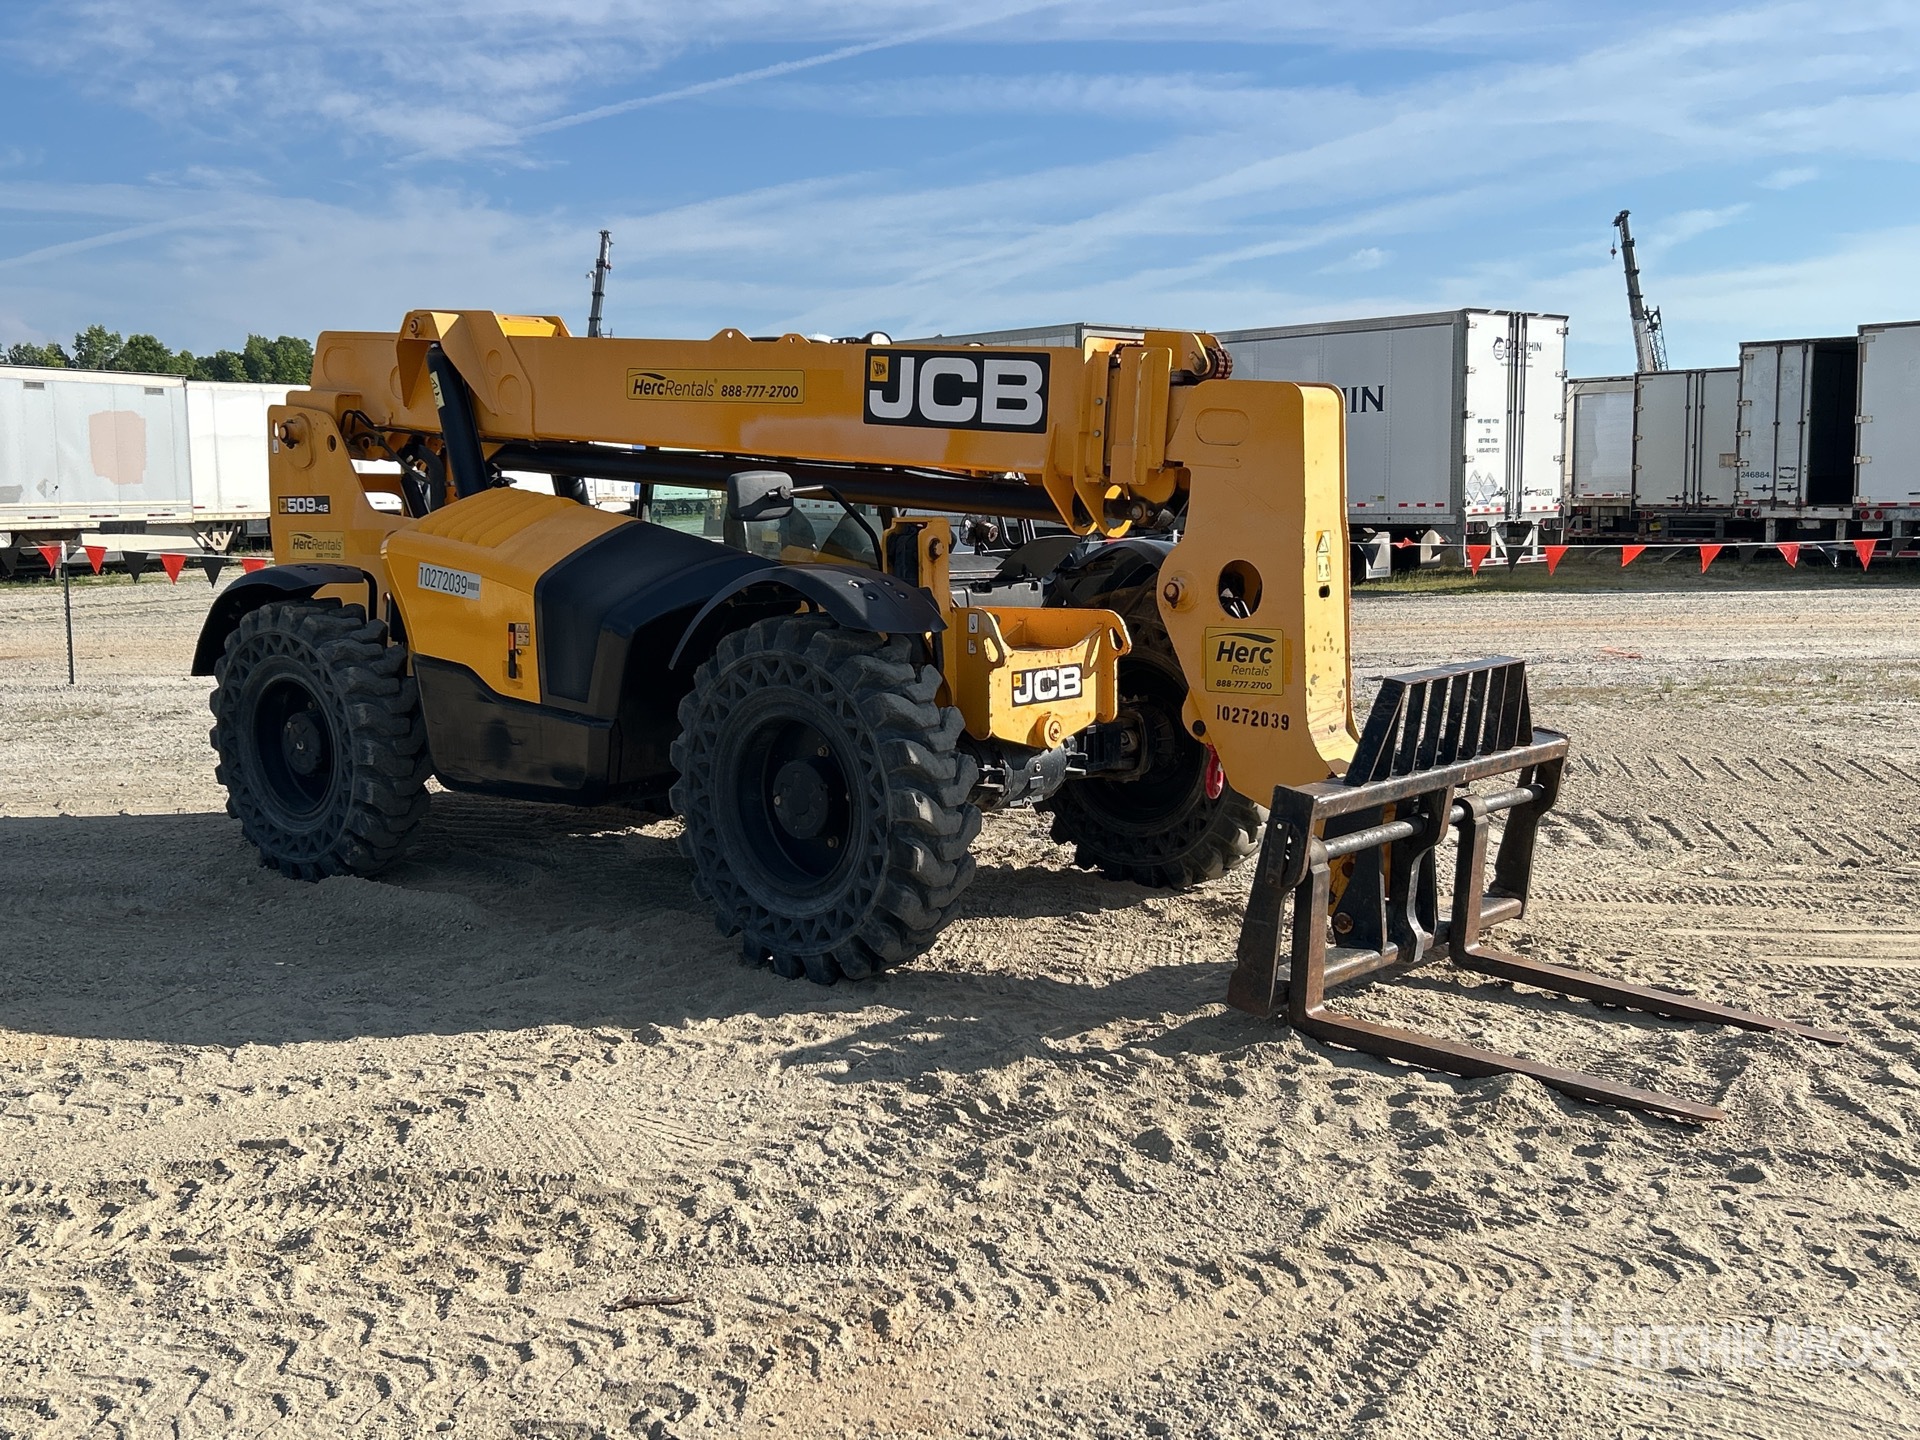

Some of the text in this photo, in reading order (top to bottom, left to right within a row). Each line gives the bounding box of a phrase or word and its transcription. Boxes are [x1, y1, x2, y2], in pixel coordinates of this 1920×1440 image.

[874, 361, 887, 376] JCB
[720, 385, 799, 398] 888-777-2700
[869, 356, 1043, 426] JCB
[1740, 471, 1770, 479] 246884
[419, 566, 468, 595] 10272039
[1215, 640, 1274, 664] Herc
[1231, 665, 1270, 677] Rentals
[1013, 666, 1082, 704] JCB
[1215, 679, 1273, 690] 888-777-2700
[1216, 704, 1290, 731] 10272039
